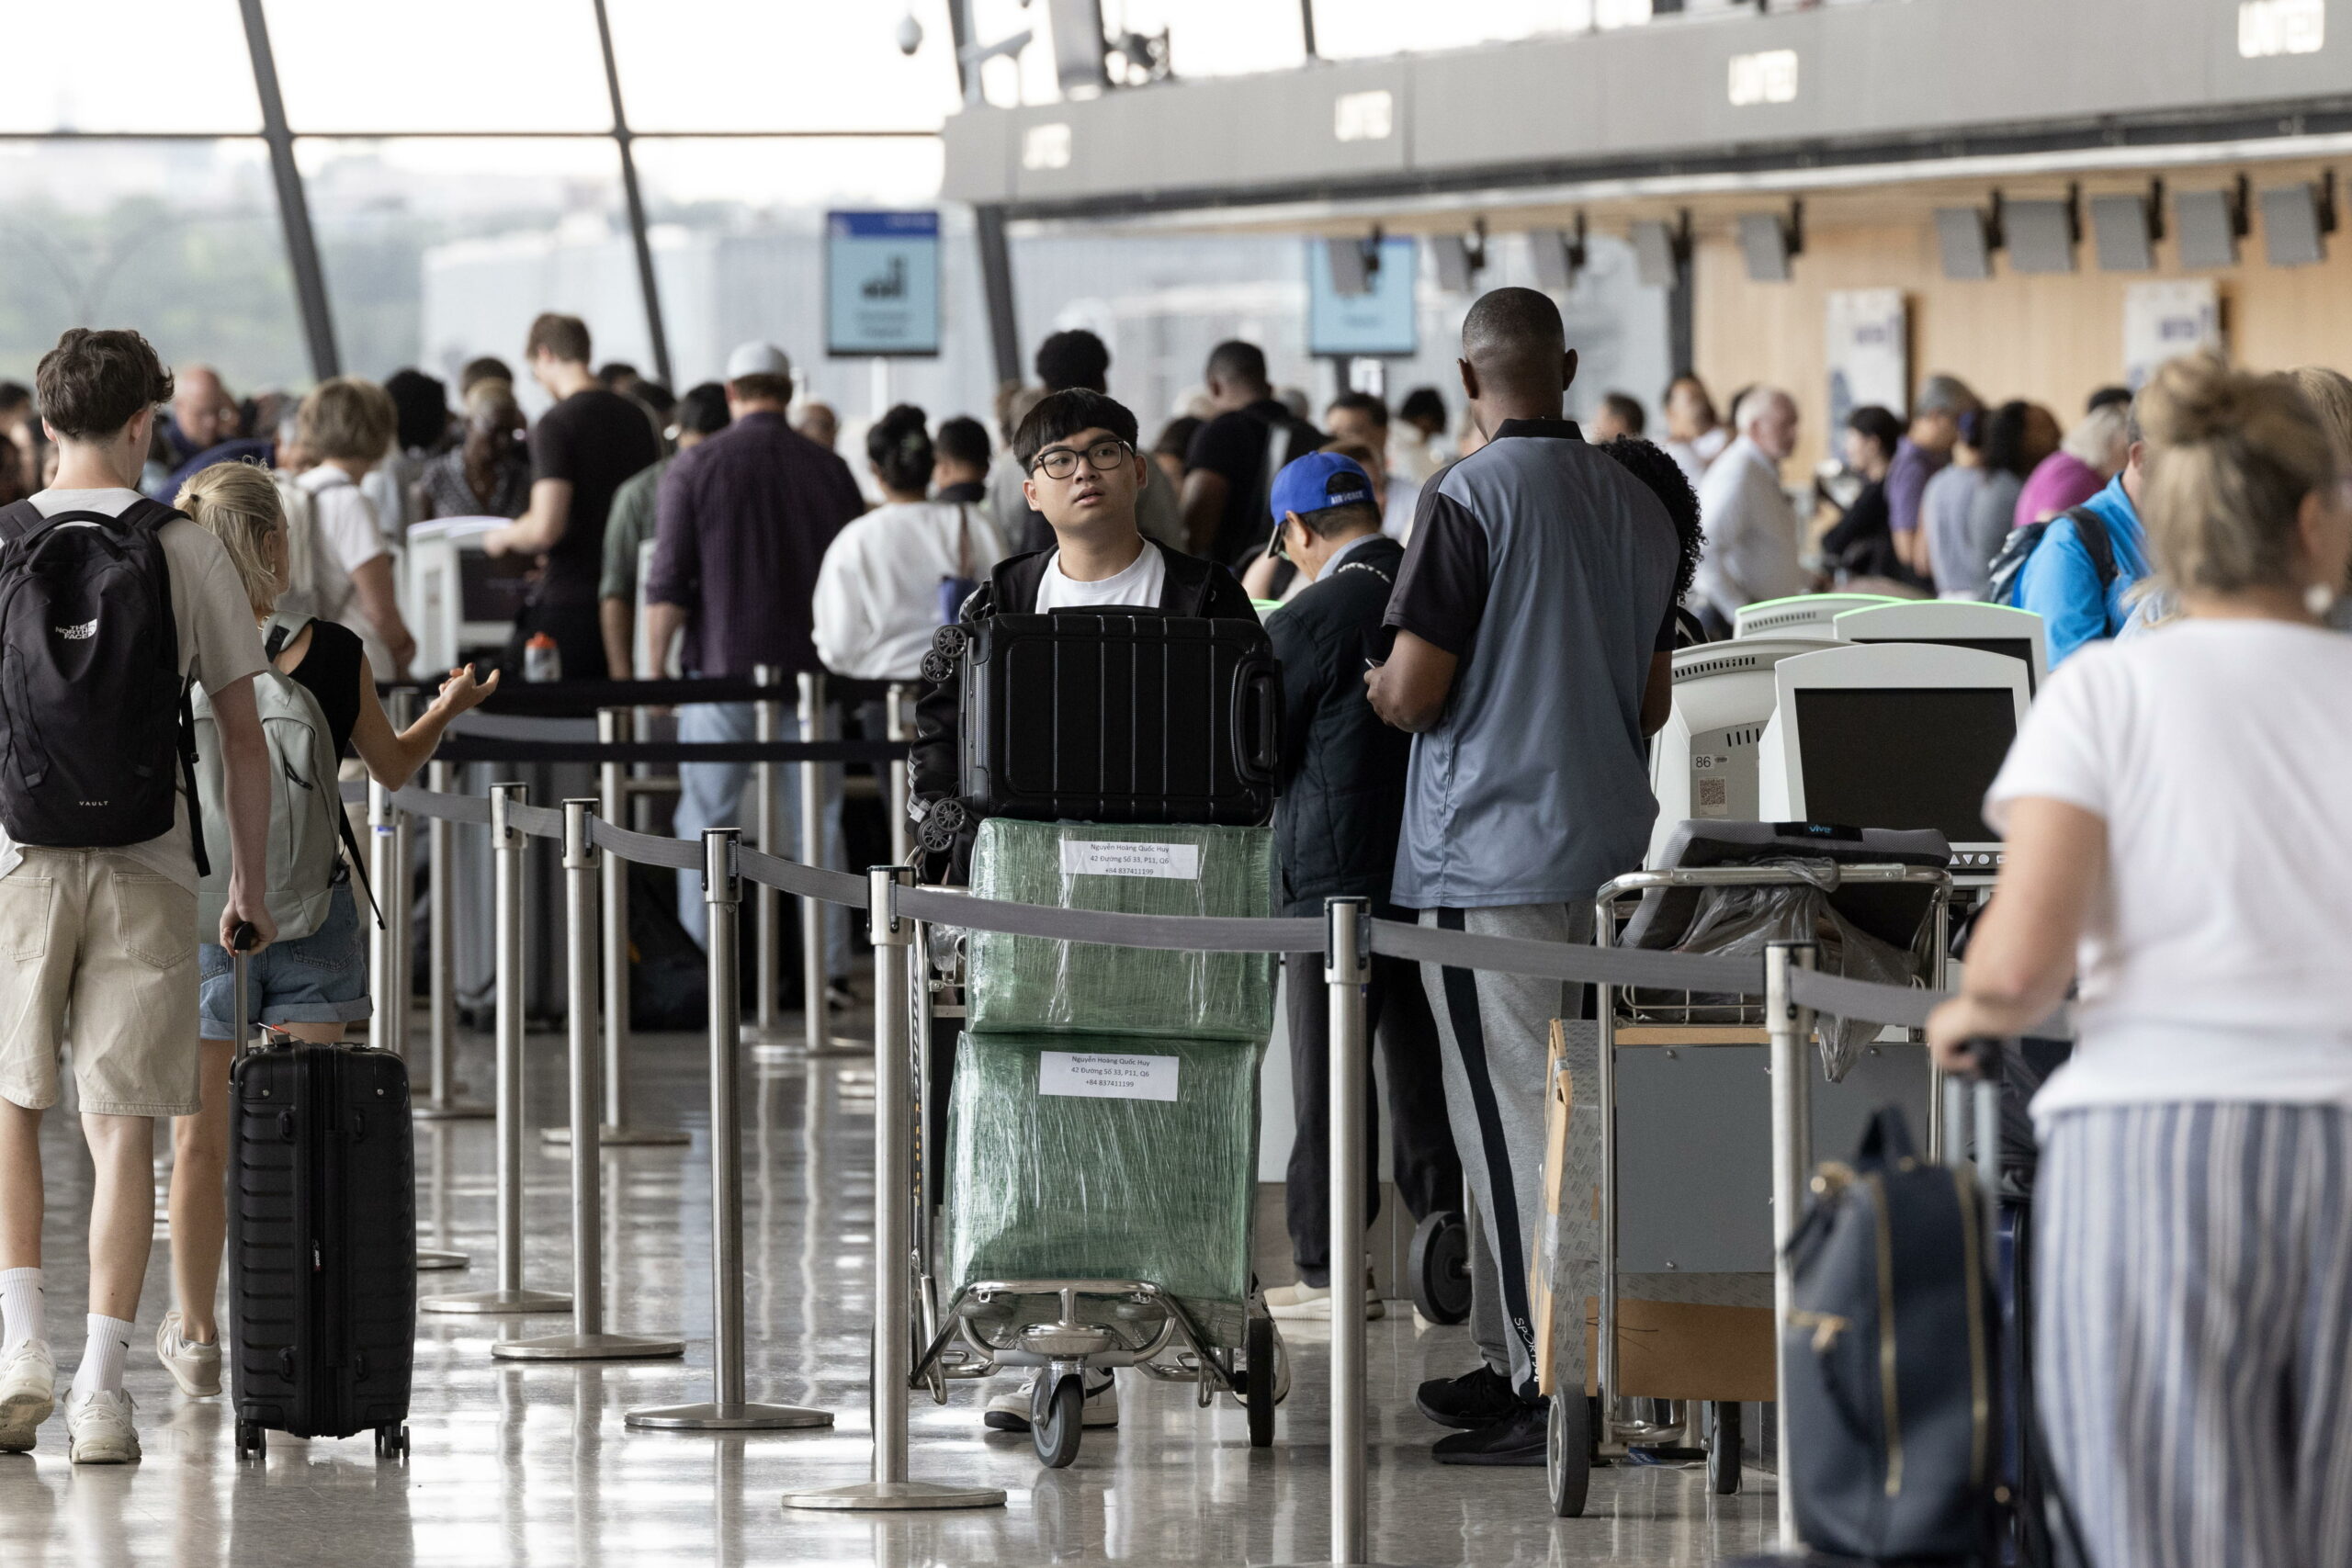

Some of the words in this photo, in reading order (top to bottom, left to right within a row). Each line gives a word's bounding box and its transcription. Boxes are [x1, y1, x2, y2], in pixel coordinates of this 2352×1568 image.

[55, 626, 88, 635] NORTH
[1695, 756, 1711, 768] 86
[1114, 1068, 1124, 1077] 33,
[1098, 1079, 1135, 1088] 837411199
